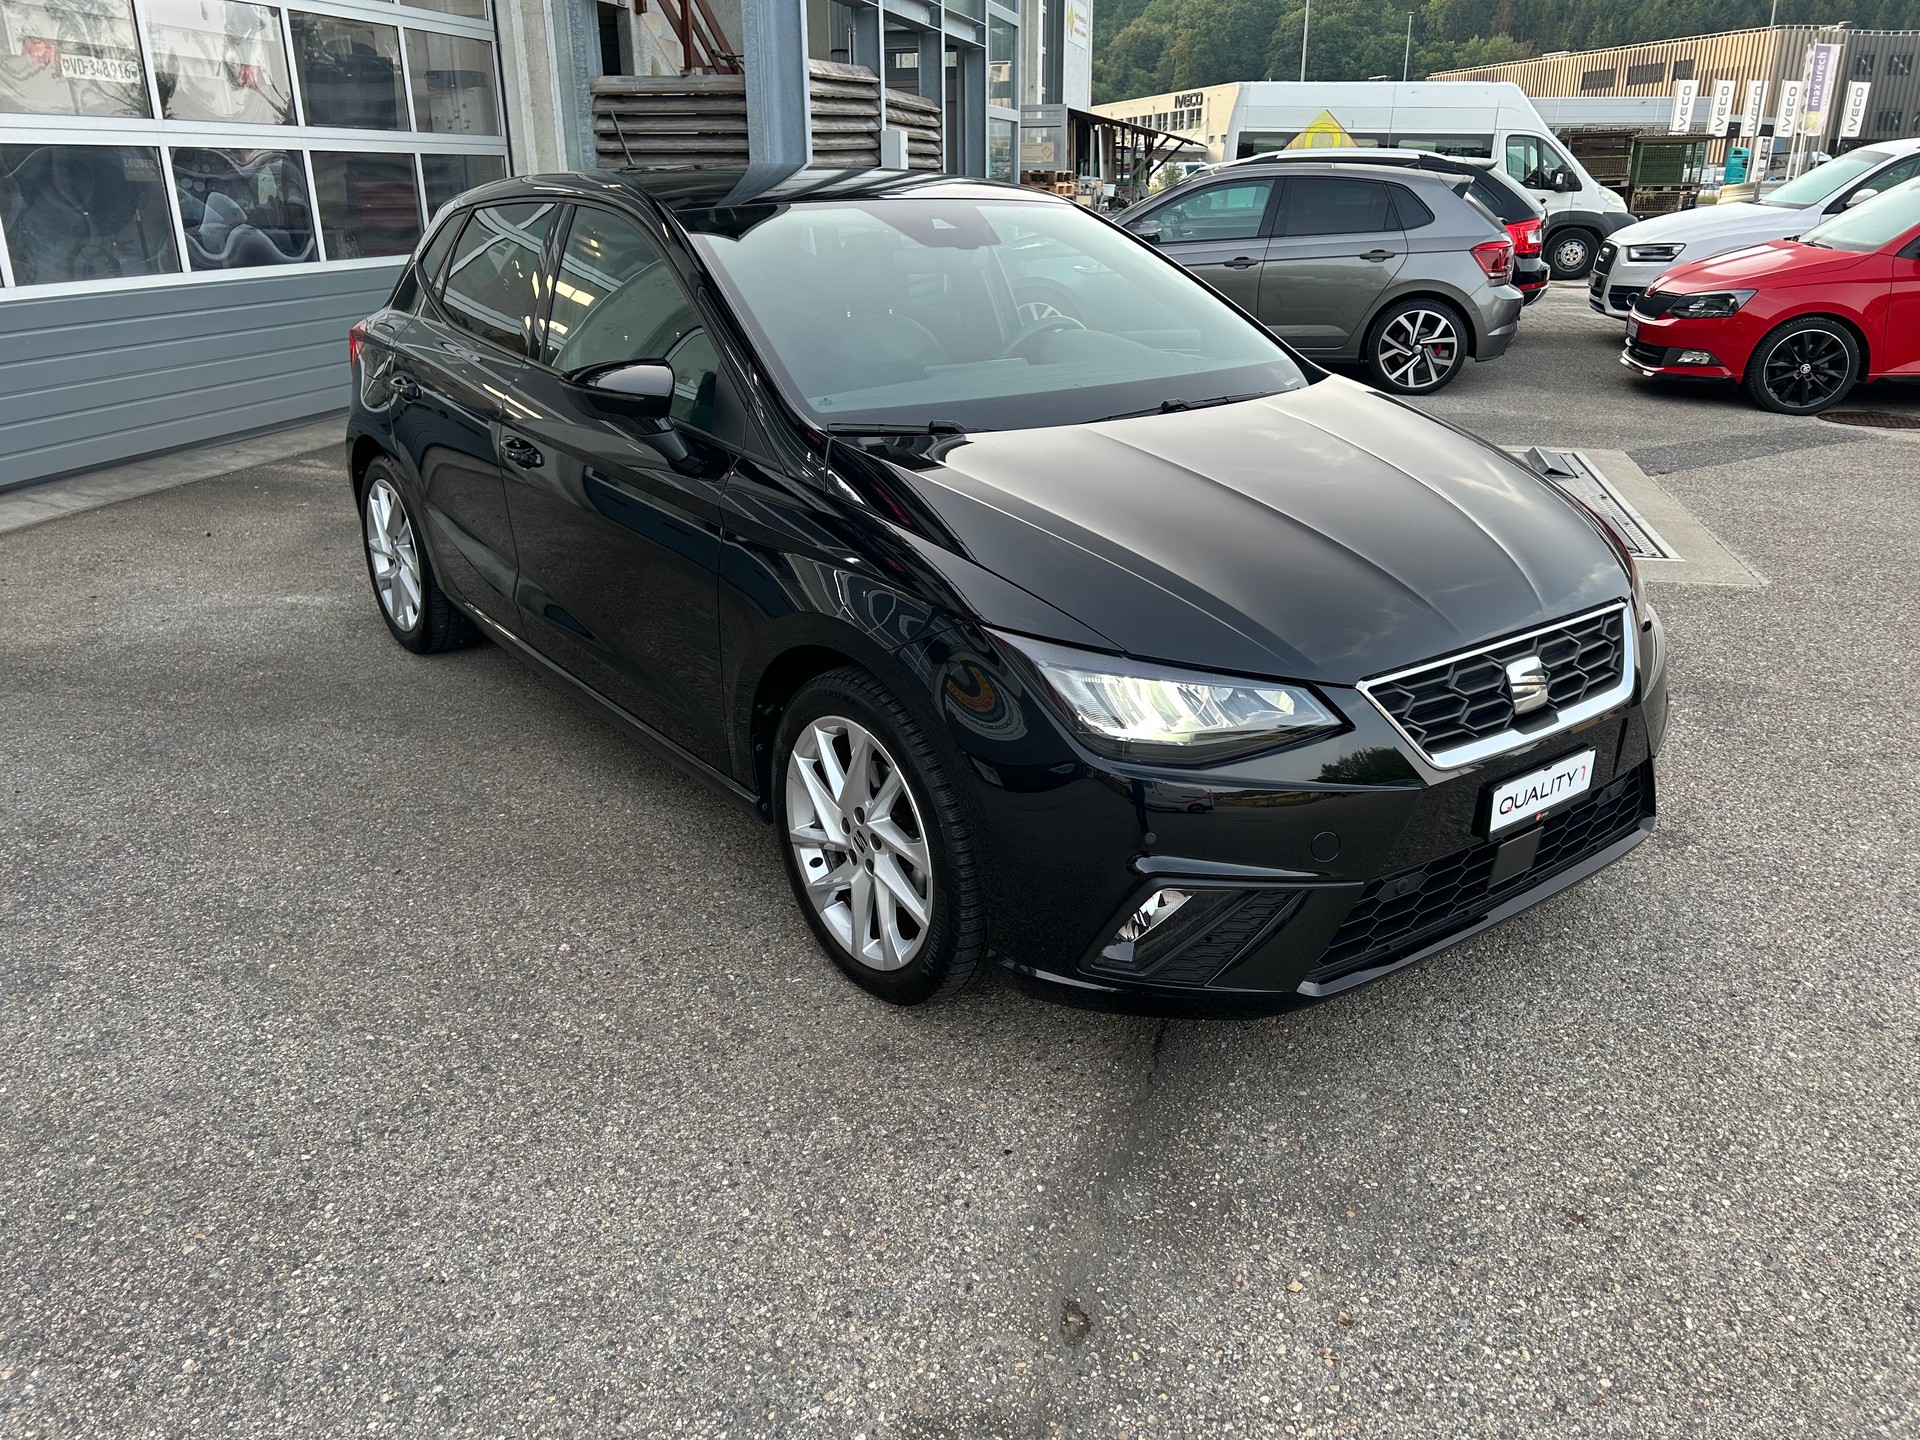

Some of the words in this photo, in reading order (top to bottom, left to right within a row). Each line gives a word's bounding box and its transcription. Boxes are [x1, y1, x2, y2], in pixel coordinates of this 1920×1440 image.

[1815, 52, 1827, 82] urech
[1174, 92, 1203, 109] IVECO
[1678, 85, 1692, 131] IVECO
[1714, 85, 1729, 132] IVECO
[1781, 86, 1798, 132] IVECO
[1811, 84, 1822, 106] max
[1847, 87, 1864, 132] IVECO
[1499, 768, 1578, 815] QUALITY
[1581, 765, 1587, 781] 1
[924, 888, 947, 970] Continental
